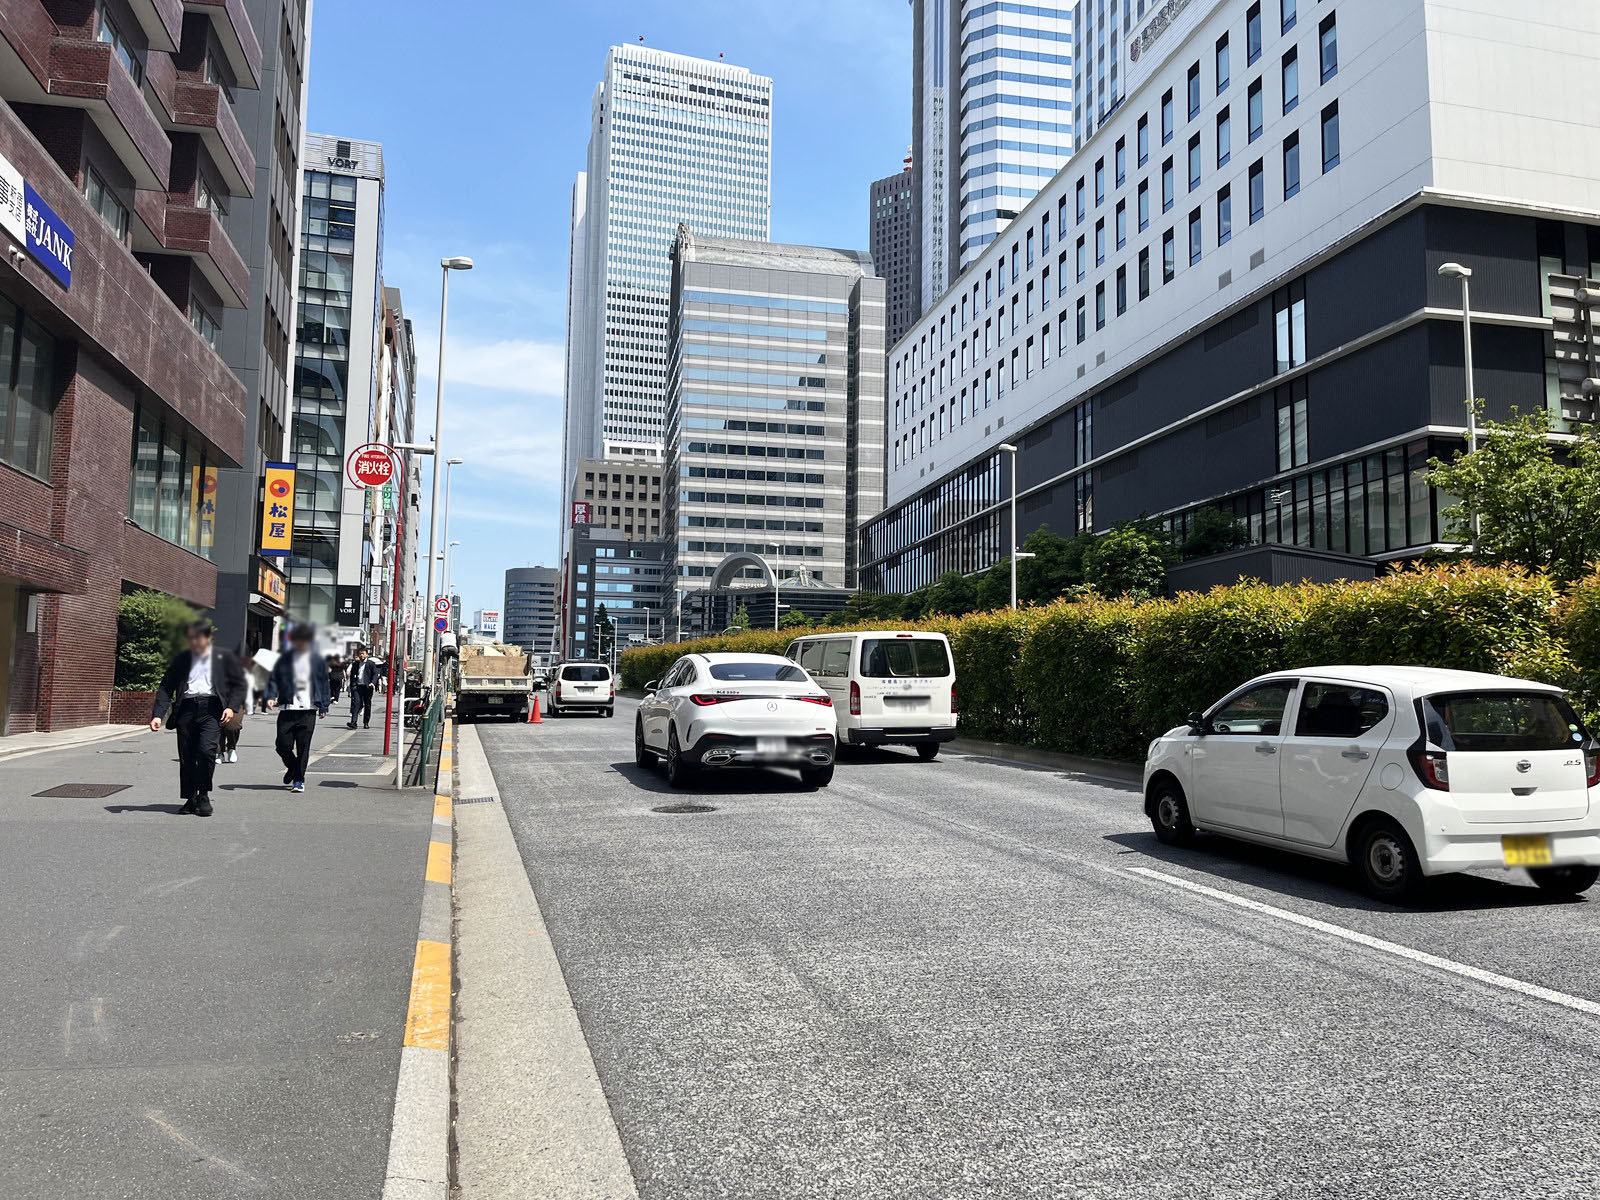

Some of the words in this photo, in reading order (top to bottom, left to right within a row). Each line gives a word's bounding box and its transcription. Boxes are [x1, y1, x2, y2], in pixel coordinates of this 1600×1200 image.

[328, 157, 359, 170] VORT
[36, 217, 73, 271] JANK
[357, 460, 391, 476] 消火栓
[268, 502, 288, 538] 松屋
